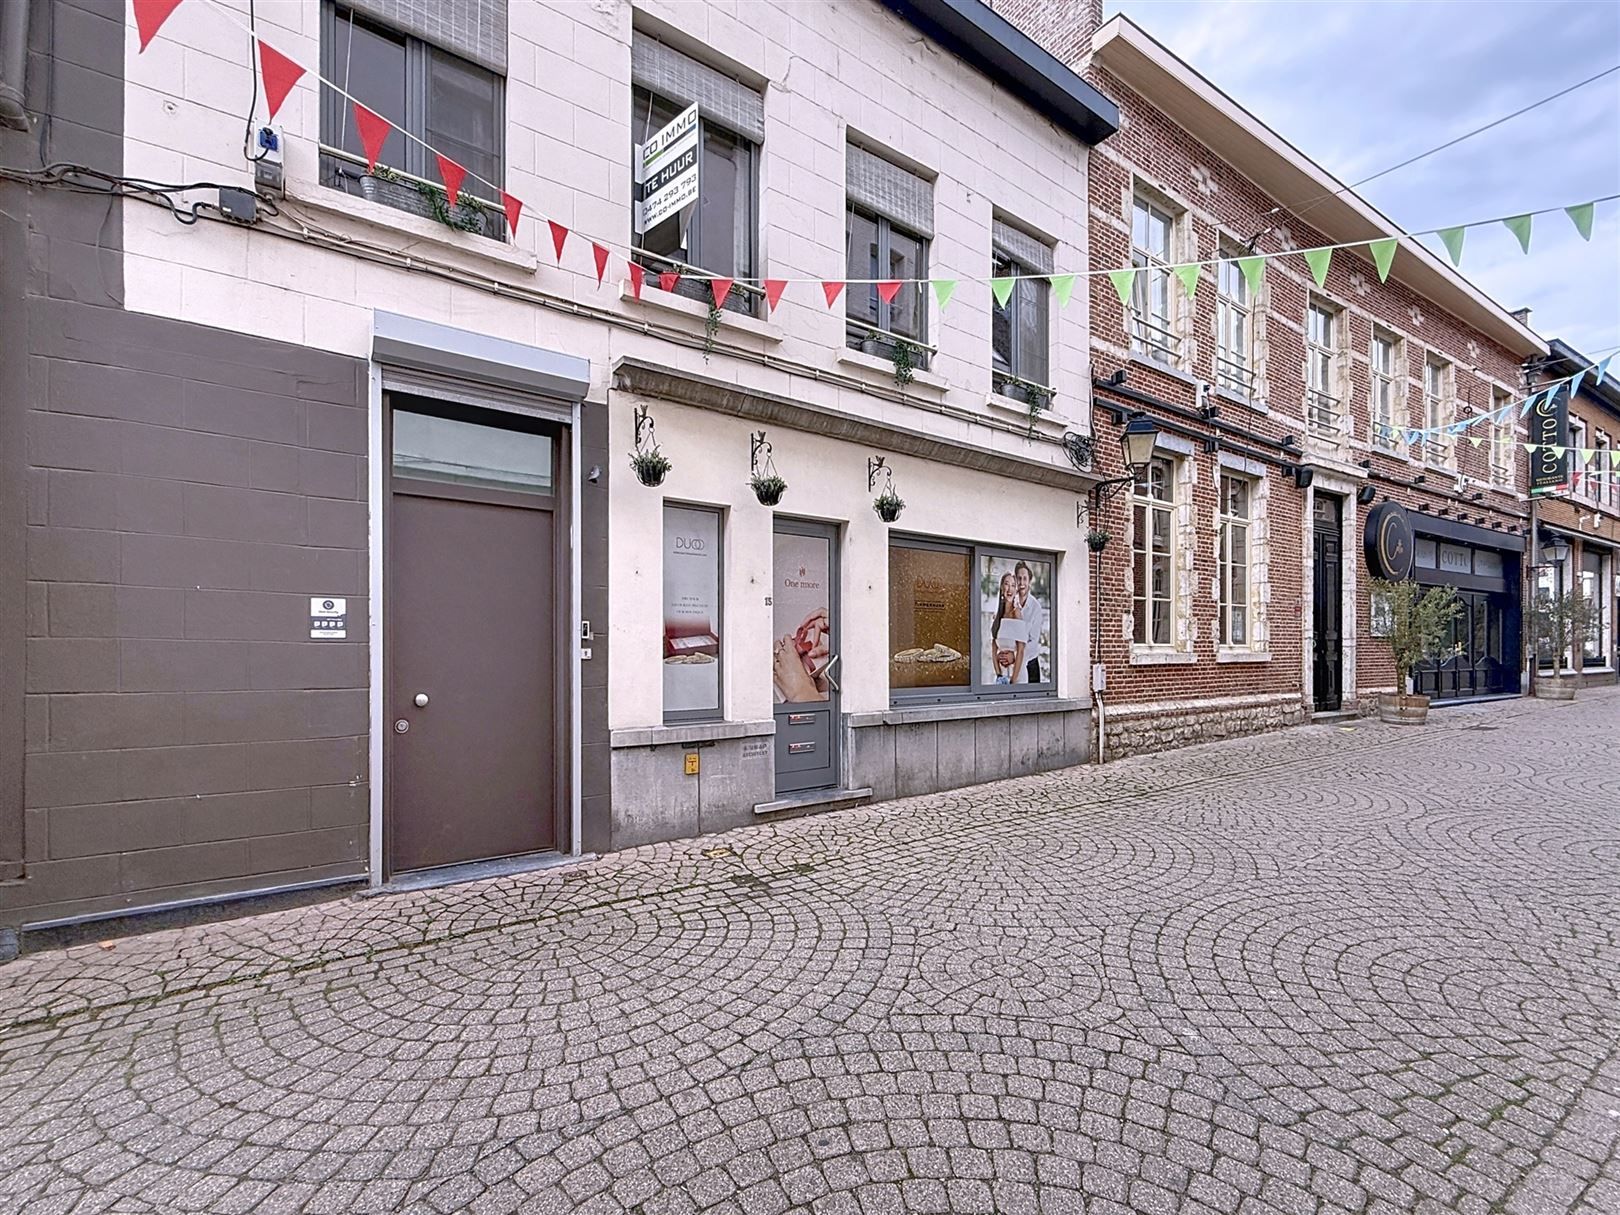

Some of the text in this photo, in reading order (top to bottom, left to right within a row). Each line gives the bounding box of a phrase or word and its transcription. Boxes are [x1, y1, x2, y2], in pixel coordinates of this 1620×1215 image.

[643, 140, 658, 159] CO
[661, 109, 697, 145] IMMO
[645, 151, 693, 194] TE HUUR
[643, 173, 697, 217] 0474 293 793
[784, 578, 799, 588] One
